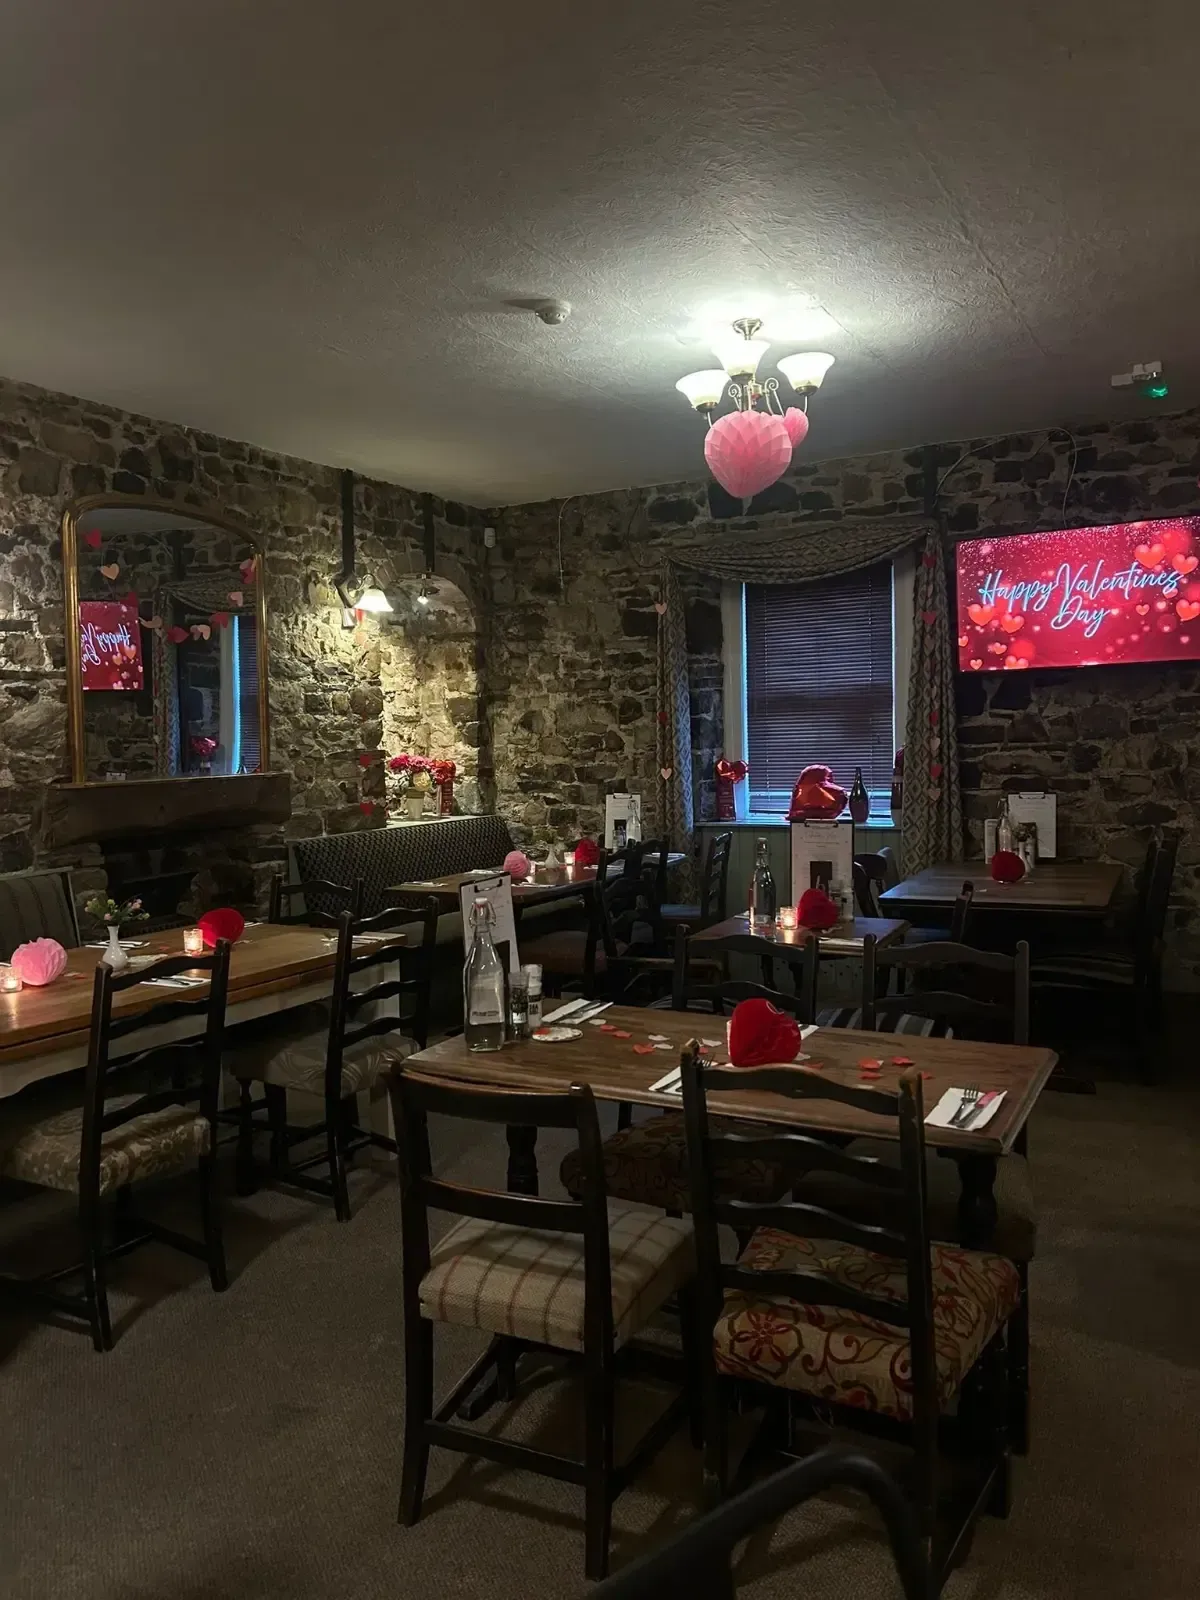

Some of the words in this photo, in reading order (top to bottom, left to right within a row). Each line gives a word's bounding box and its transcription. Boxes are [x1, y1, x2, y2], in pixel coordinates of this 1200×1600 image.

[979, 570, 1057, 612] Happy
[1052, 559, 1184, 604] Valentines
[1051, 595, 1112, 638] Day
